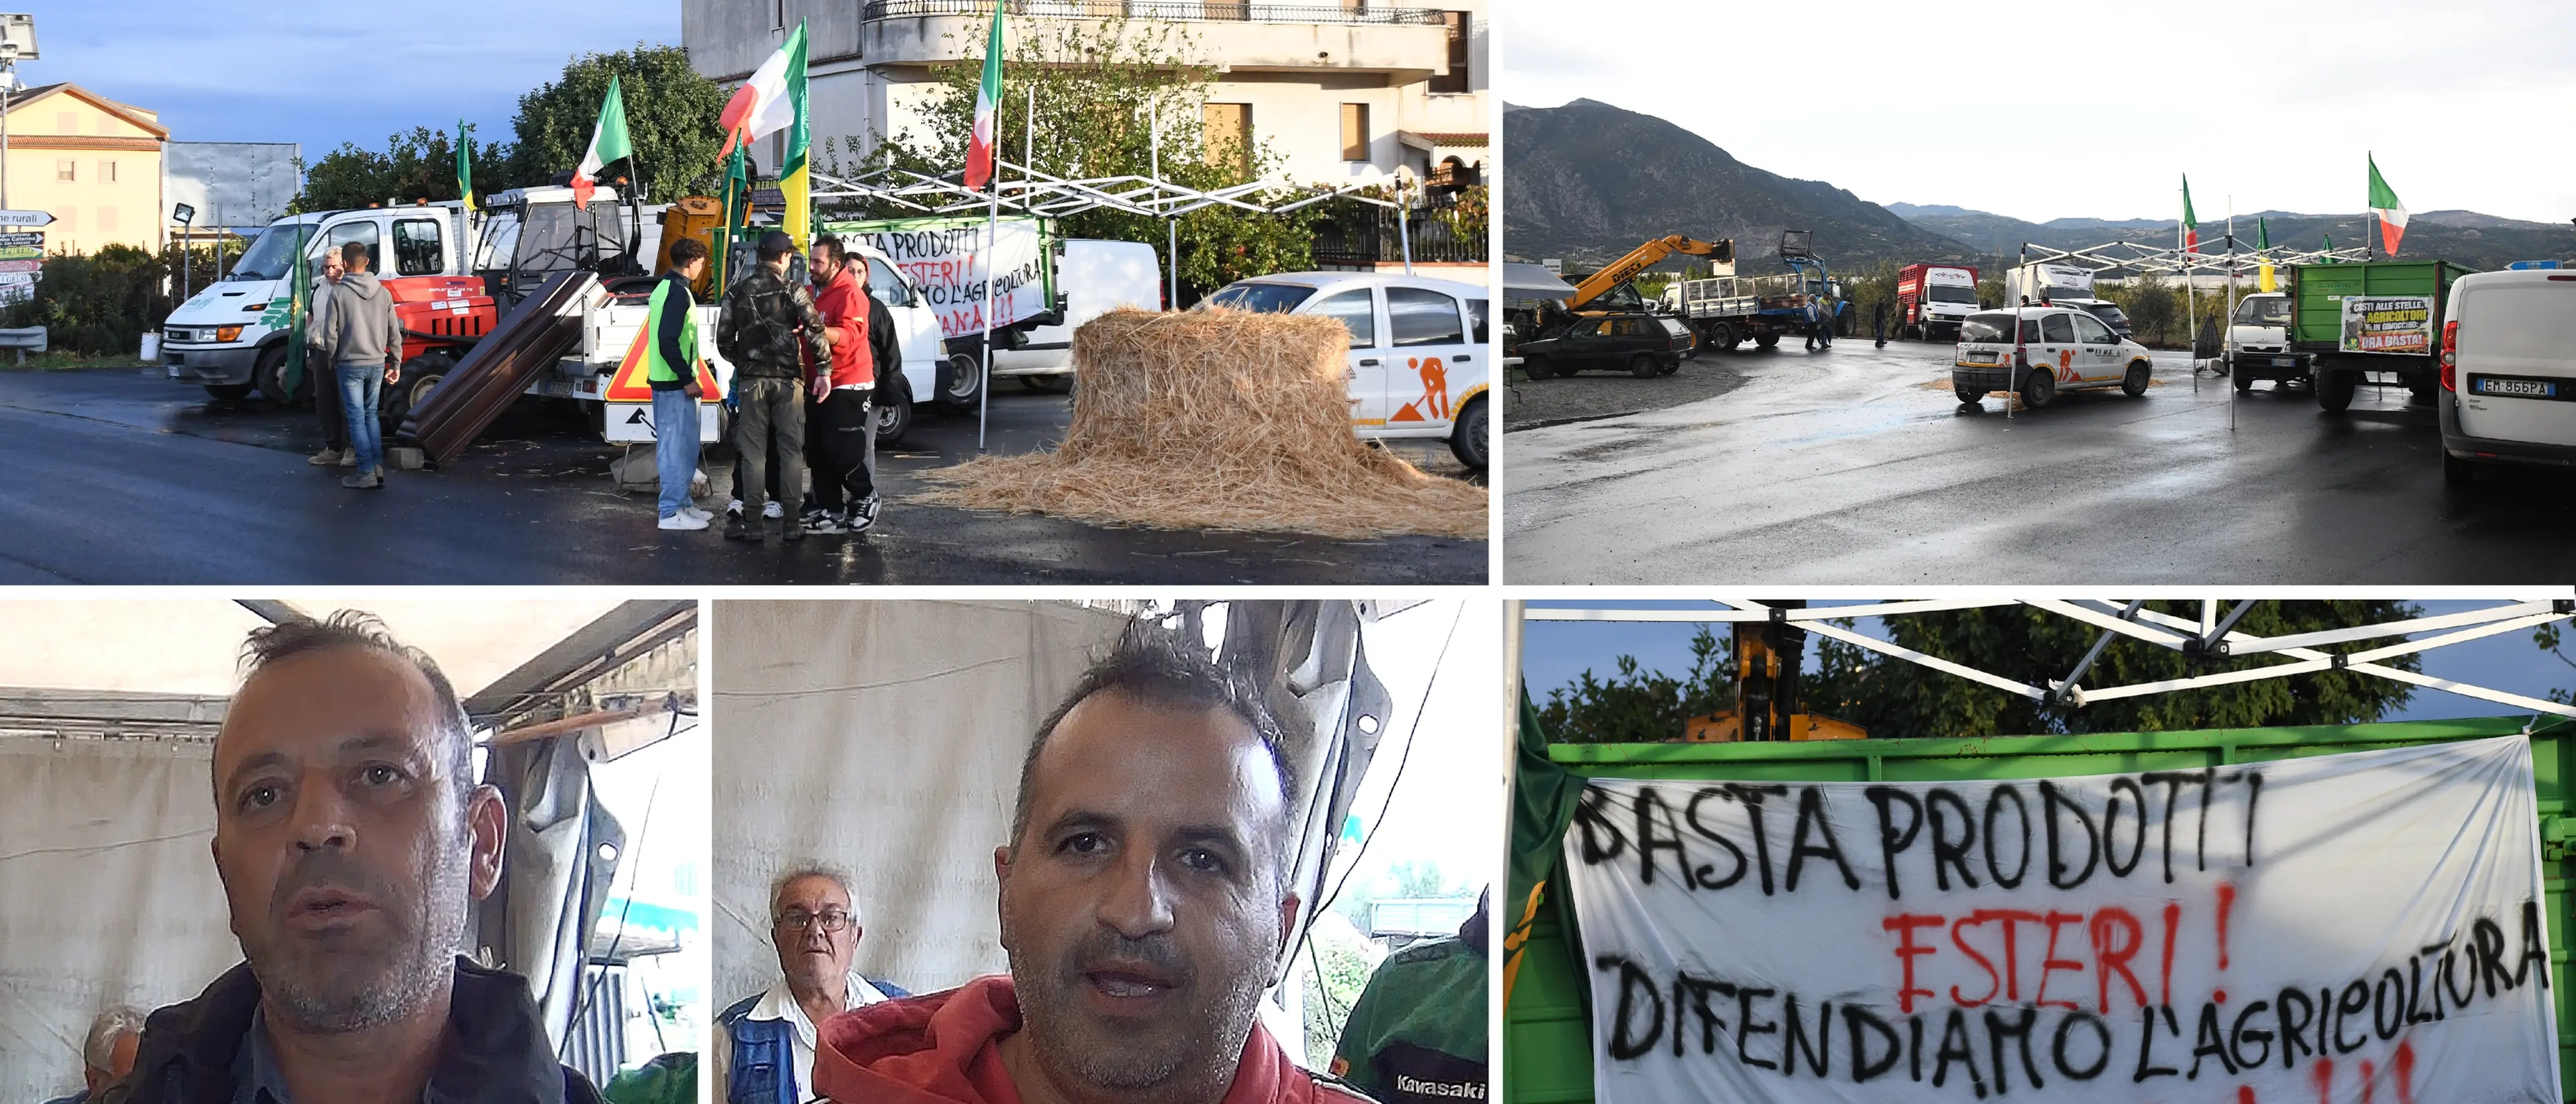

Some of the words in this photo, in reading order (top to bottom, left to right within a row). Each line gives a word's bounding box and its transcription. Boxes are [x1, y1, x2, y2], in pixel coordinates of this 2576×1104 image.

[12, 214, 38, 223] rurali
[891, 227, 979, 260] PRODOTTI
[2353, 302, 2373, 313] COSTI
[2375, 301, 2393, 311] ALLE
[2394, 301, 2424, 309] STELLE,
[2366, 309, 2426, 323] AGRICOLTORI
[2382, 321, 2418, 331] GINOCCHIO:
[2361, 336, 2383, 348] ORA
[2385, 334, 2423, 347] BASTA!
[1865, 766, 2263, 900] PRODOTTI
[1595, 953, 2112, 1099] DIFENDIAMO
[1397, 1074, 1486, 1099] Kawasaki
